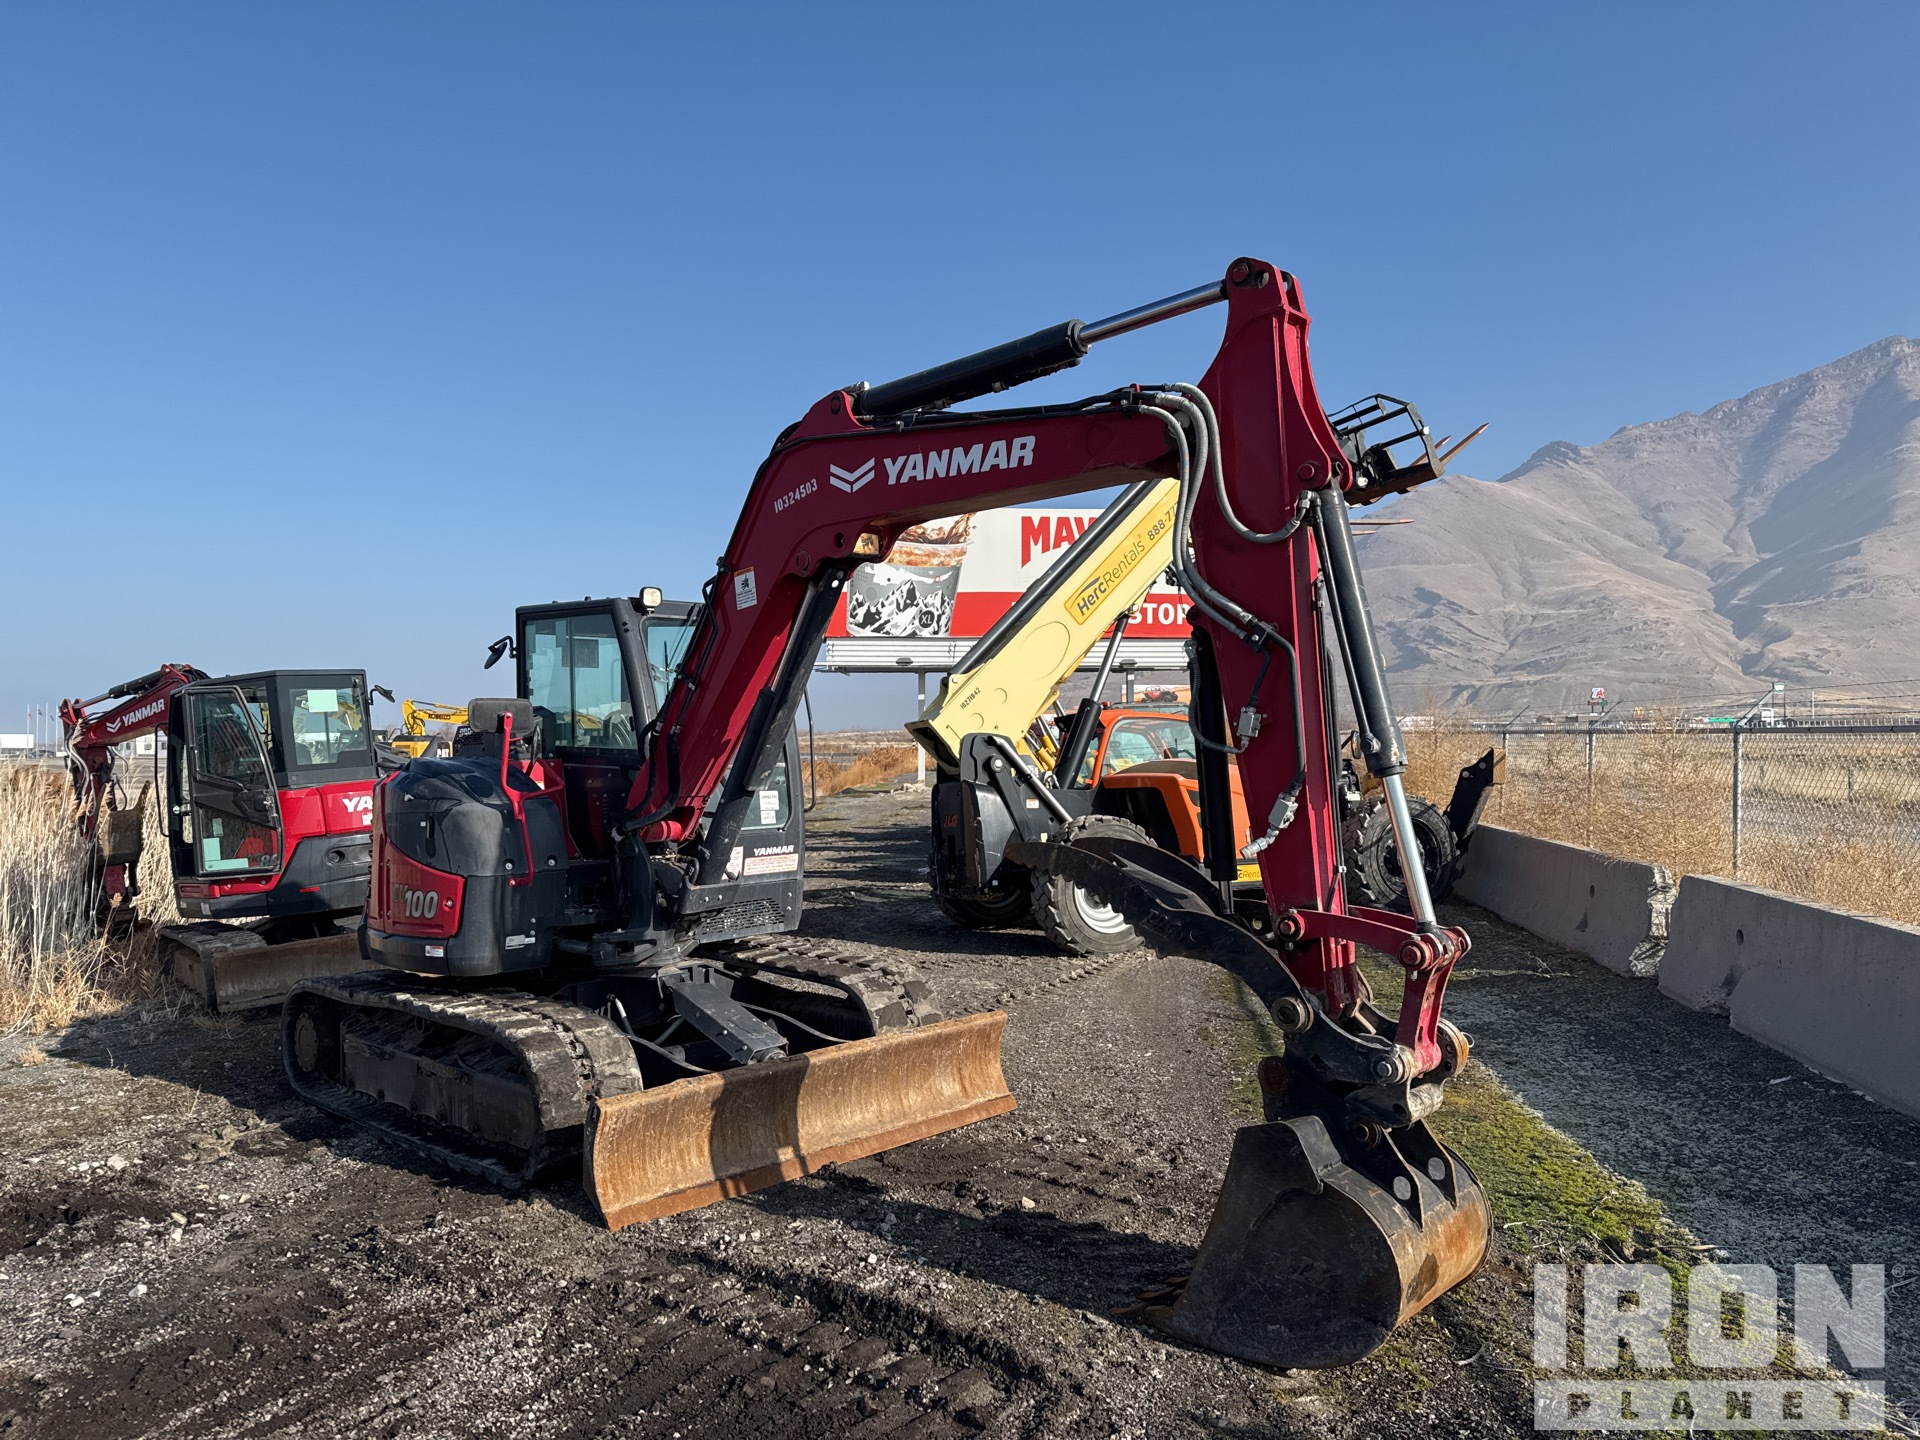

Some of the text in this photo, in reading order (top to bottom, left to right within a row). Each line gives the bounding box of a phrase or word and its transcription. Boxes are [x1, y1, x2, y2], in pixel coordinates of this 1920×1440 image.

[883, 435, 1036, 485] YANMAR
[774, 478, 818, 514] 10324503
[1076, 501, 1179, 617] HercRentals 888-77
[920, 614, 933, 625] XL
[1591, 687, 1605, 699] TA
[122, 698, 165, 727] YANMAR
[428, 713, 452, 721] KOBELCO
[341, 795, 373, 813] YA
[753, 844, 795, 856] YANMAR
